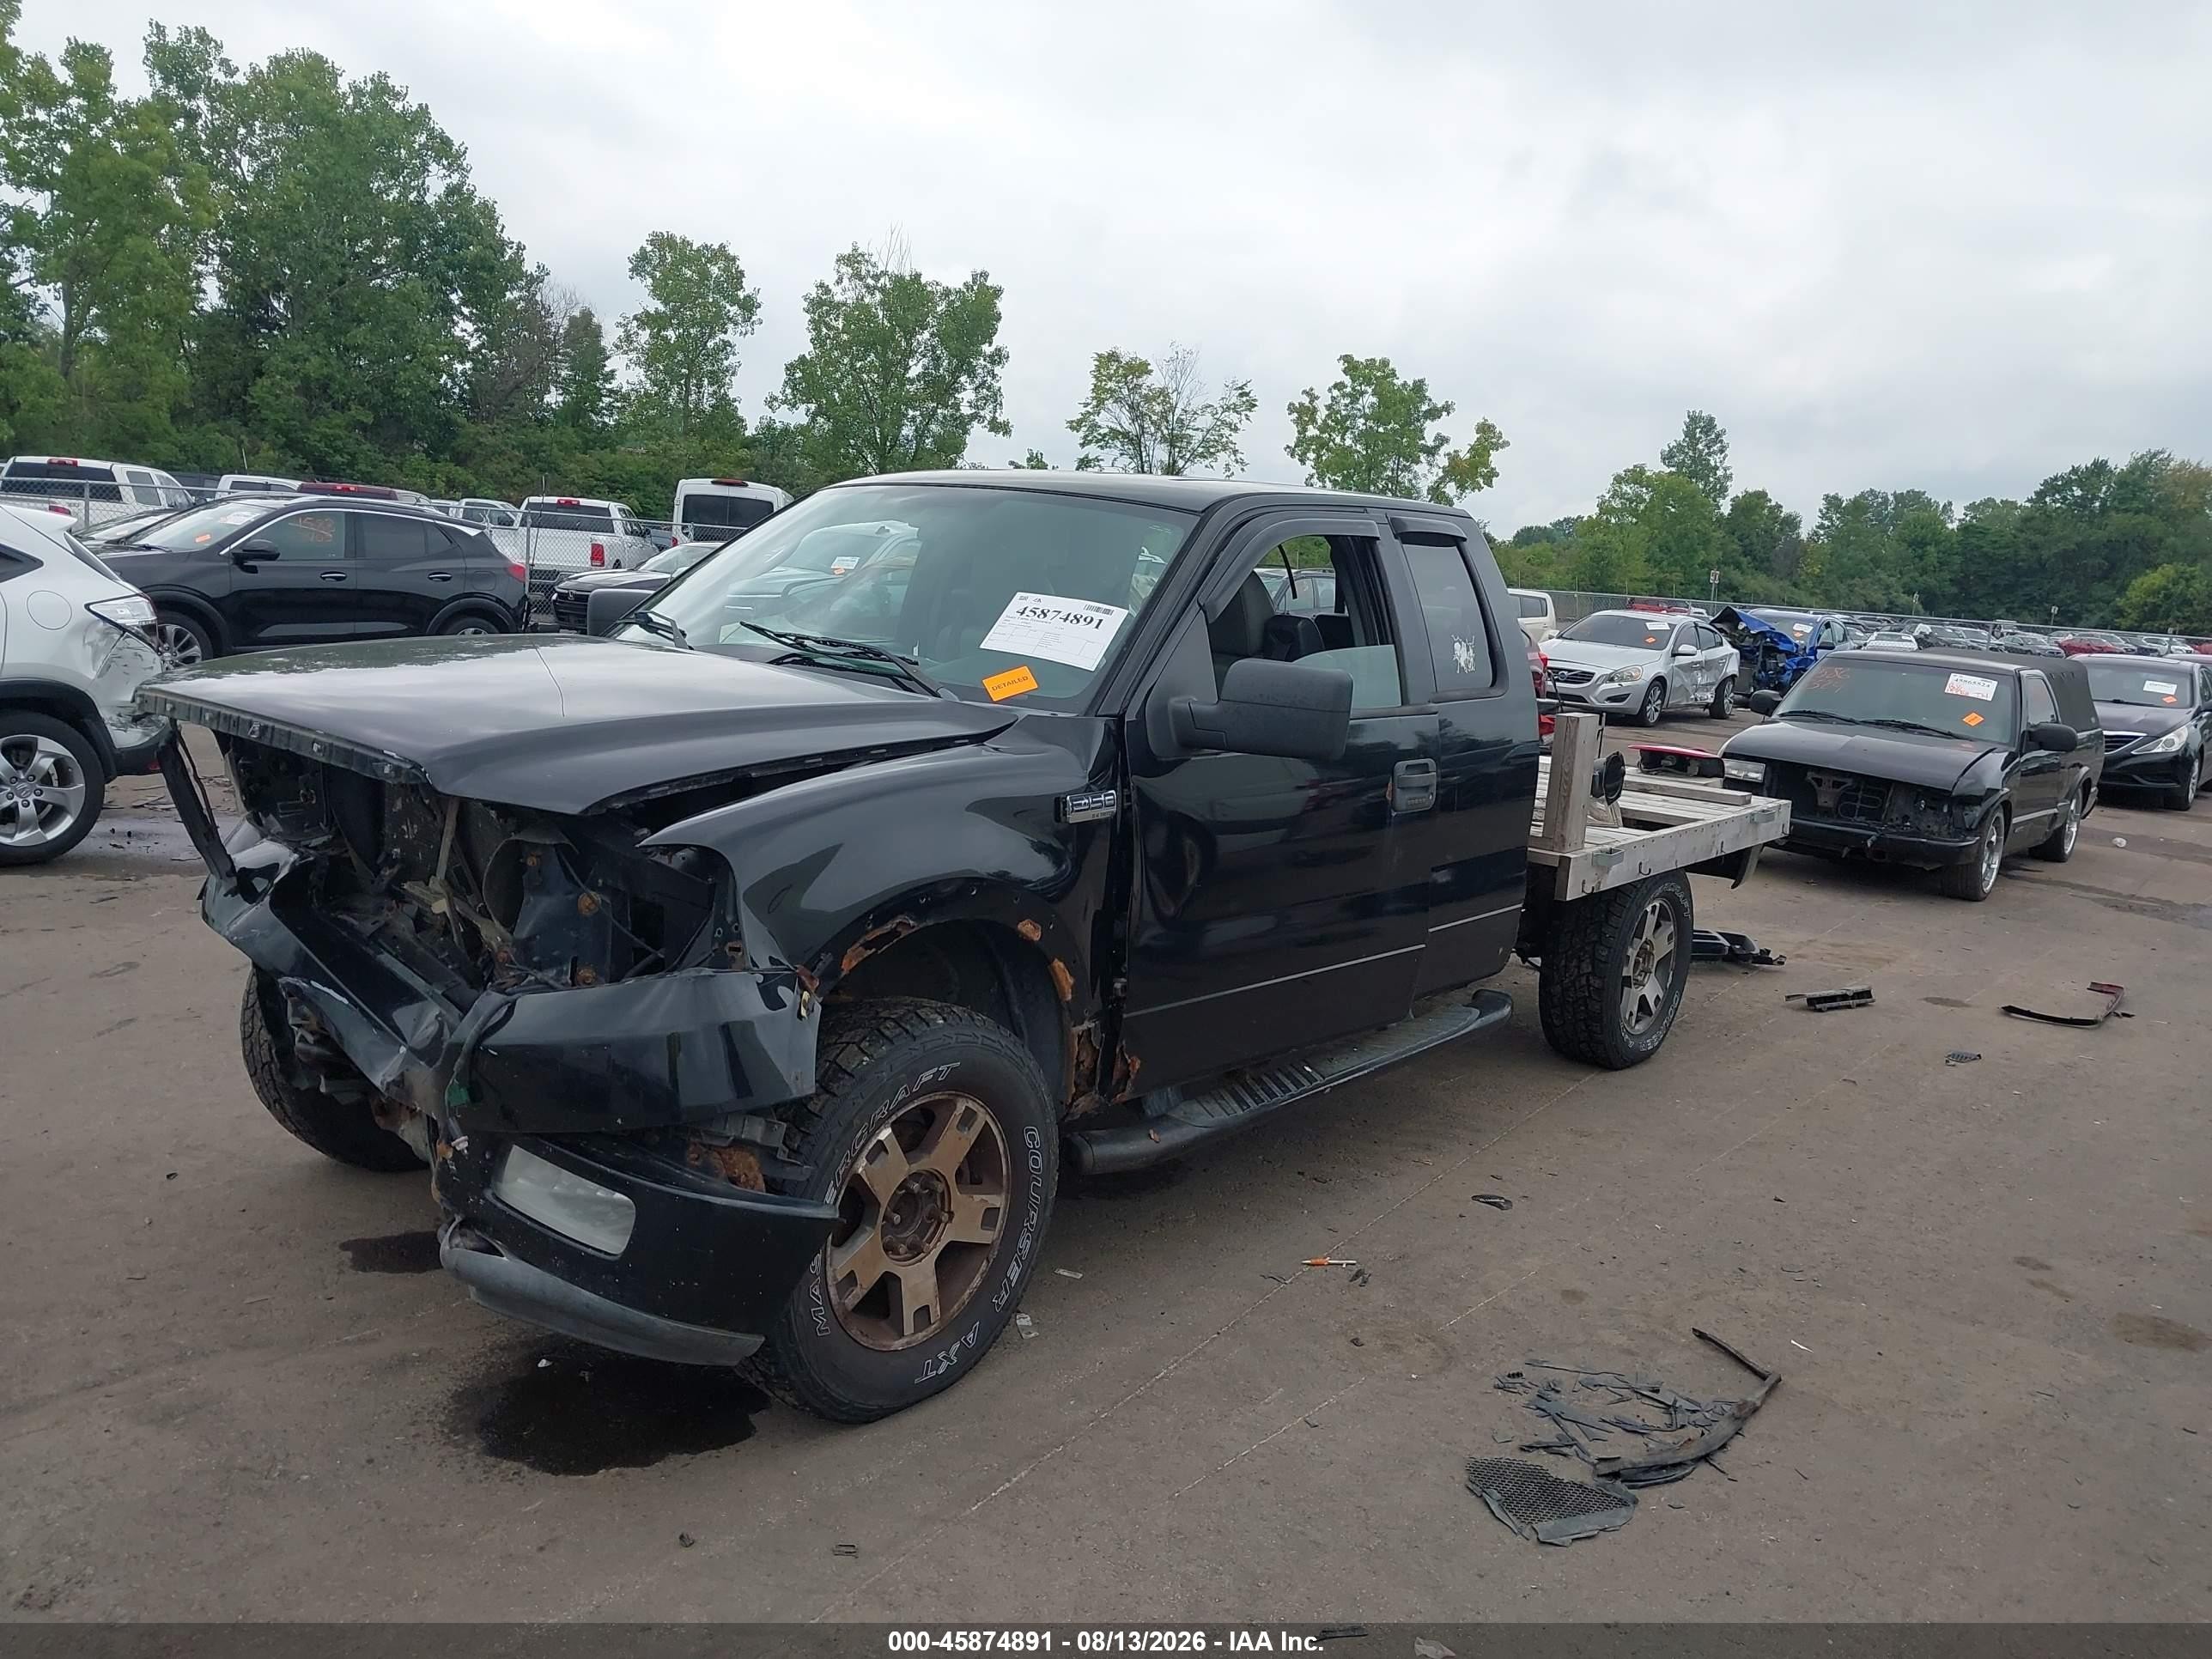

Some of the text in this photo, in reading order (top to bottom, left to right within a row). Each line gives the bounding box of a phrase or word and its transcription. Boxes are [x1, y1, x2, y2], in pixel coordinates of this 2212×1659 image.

[1016, 605, 1103, 630] 45874891
[992, 676, 1029, 691] DETAILED
[991, 1126, 1043, 1313] COURSER
[914, 1320, 981, 1384] AXT
